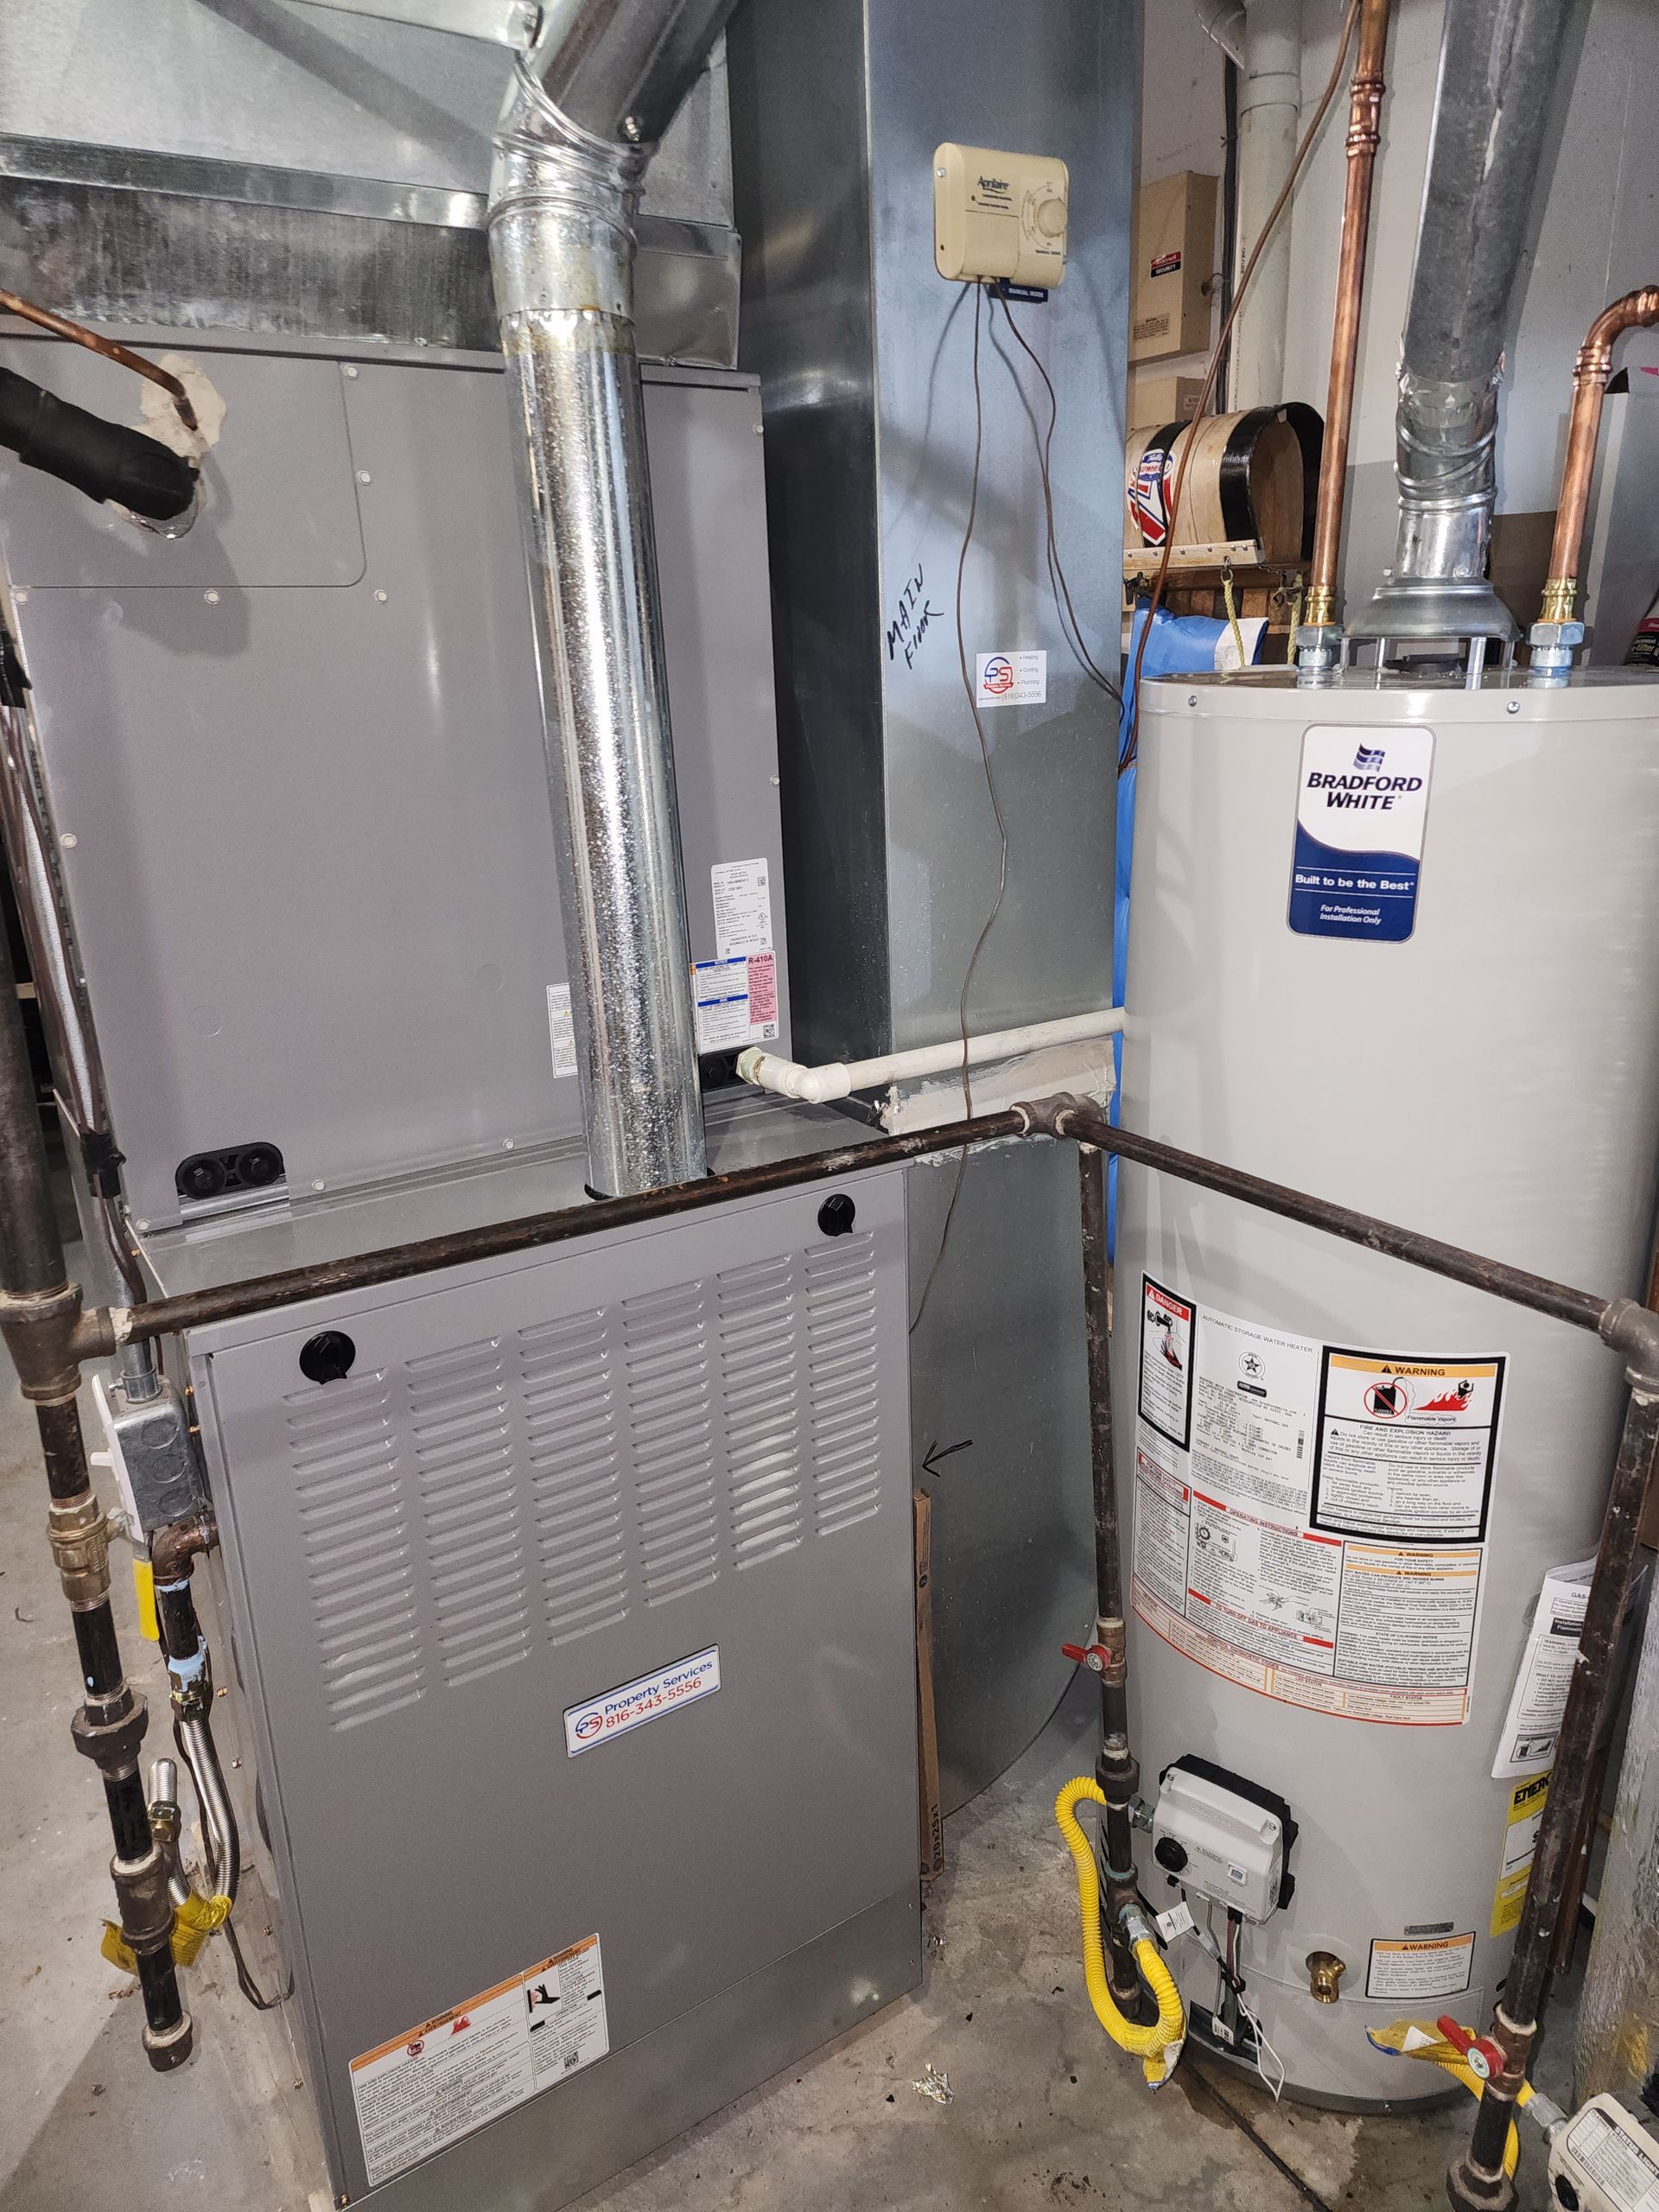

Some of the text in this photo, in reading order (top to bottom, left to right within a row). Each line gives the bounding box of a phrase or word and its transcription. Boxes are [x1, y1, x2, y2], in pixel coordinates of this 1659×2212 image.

[977, 175, 1009, 190] Aprilaire
[887, 563, 923, 660] MAIN
[1306, 772, 1423, 791] BRADFORD
[1326, 791, 1395, 810] WHITE
[1295, 874, 1320, 885] Built
[1323, 876, 1335, 887] to
[1338, 878, 1354, 888] be
[1357, 879, 1376, 889] the
[1319, 912, 1382, 925] Installation Only
[1320, 904, 1381, 916] For Professional
[748, 954, 773, 964] R-410A
[1155, 1293, 1183, 1316] DANGER
[1202, 1314, 1313, 1354] AUTOMATIC STORAGE WATER HEATER
[1395, 1366, 1446, 1376] WARNING
[1230, 1508, 1298, 1537] OPERATING INSTRUCTIONS
[605, 1684, 659, 1715] Property
[663, 1661, 713, 1689] Services
[606, 1676, 702, 1729] 816-343-5556
[1409, 1941, 1449, 1951] WARNING
[1614, 2126, 1640, 2156] STATUS
